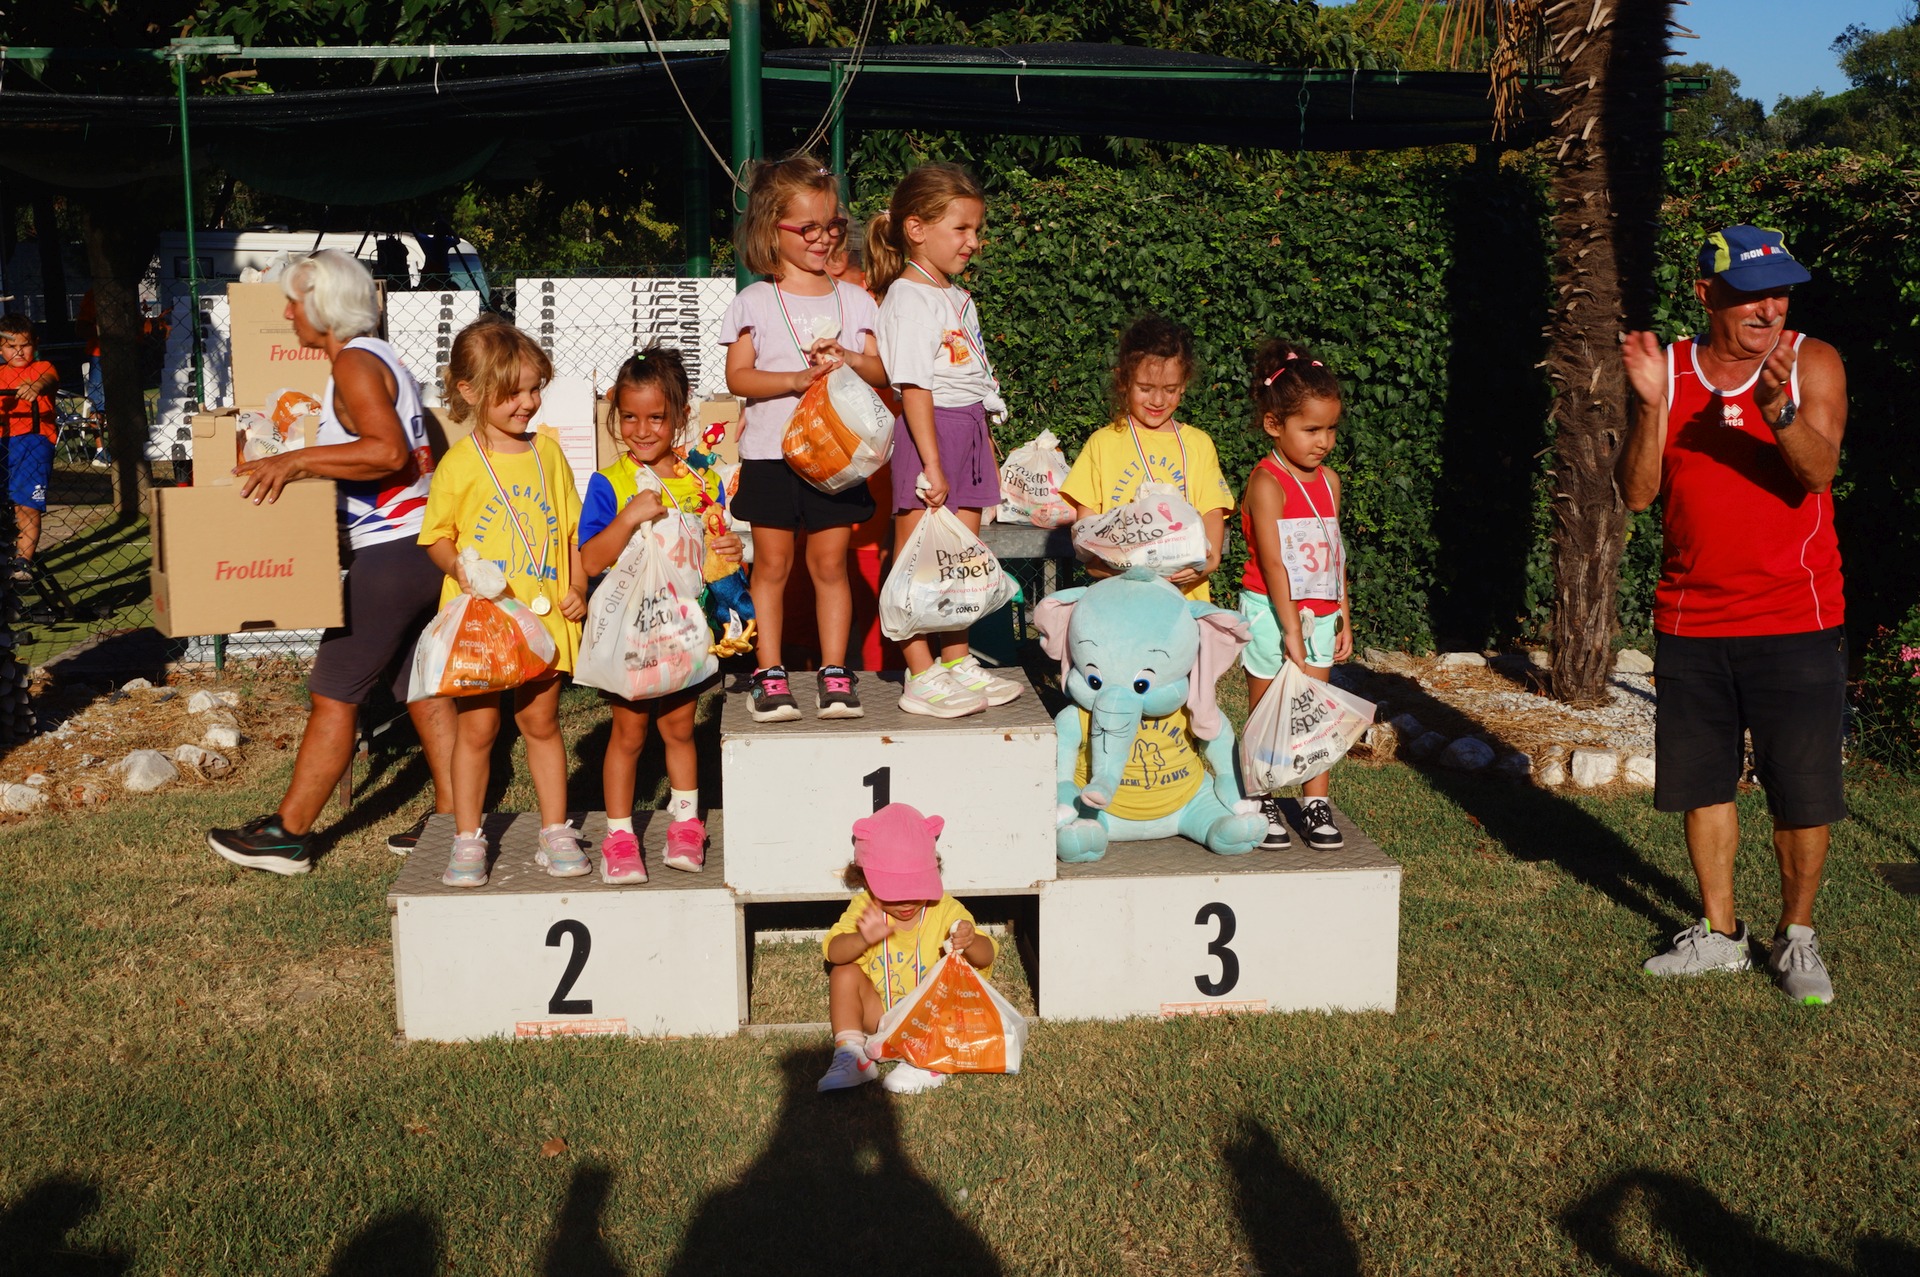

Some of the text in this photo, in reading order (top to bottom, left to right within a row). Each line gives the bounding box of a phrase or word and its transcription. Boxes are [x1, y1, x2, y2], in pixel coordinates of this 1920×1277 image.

[270, 344, 331, 361] Frollin
[215, 558, 296, 581] Frollini
[862, 766, 891, 813] 1
[545, 919, 593, 1014] 2
[1194, 902, 1240, 997] 3
